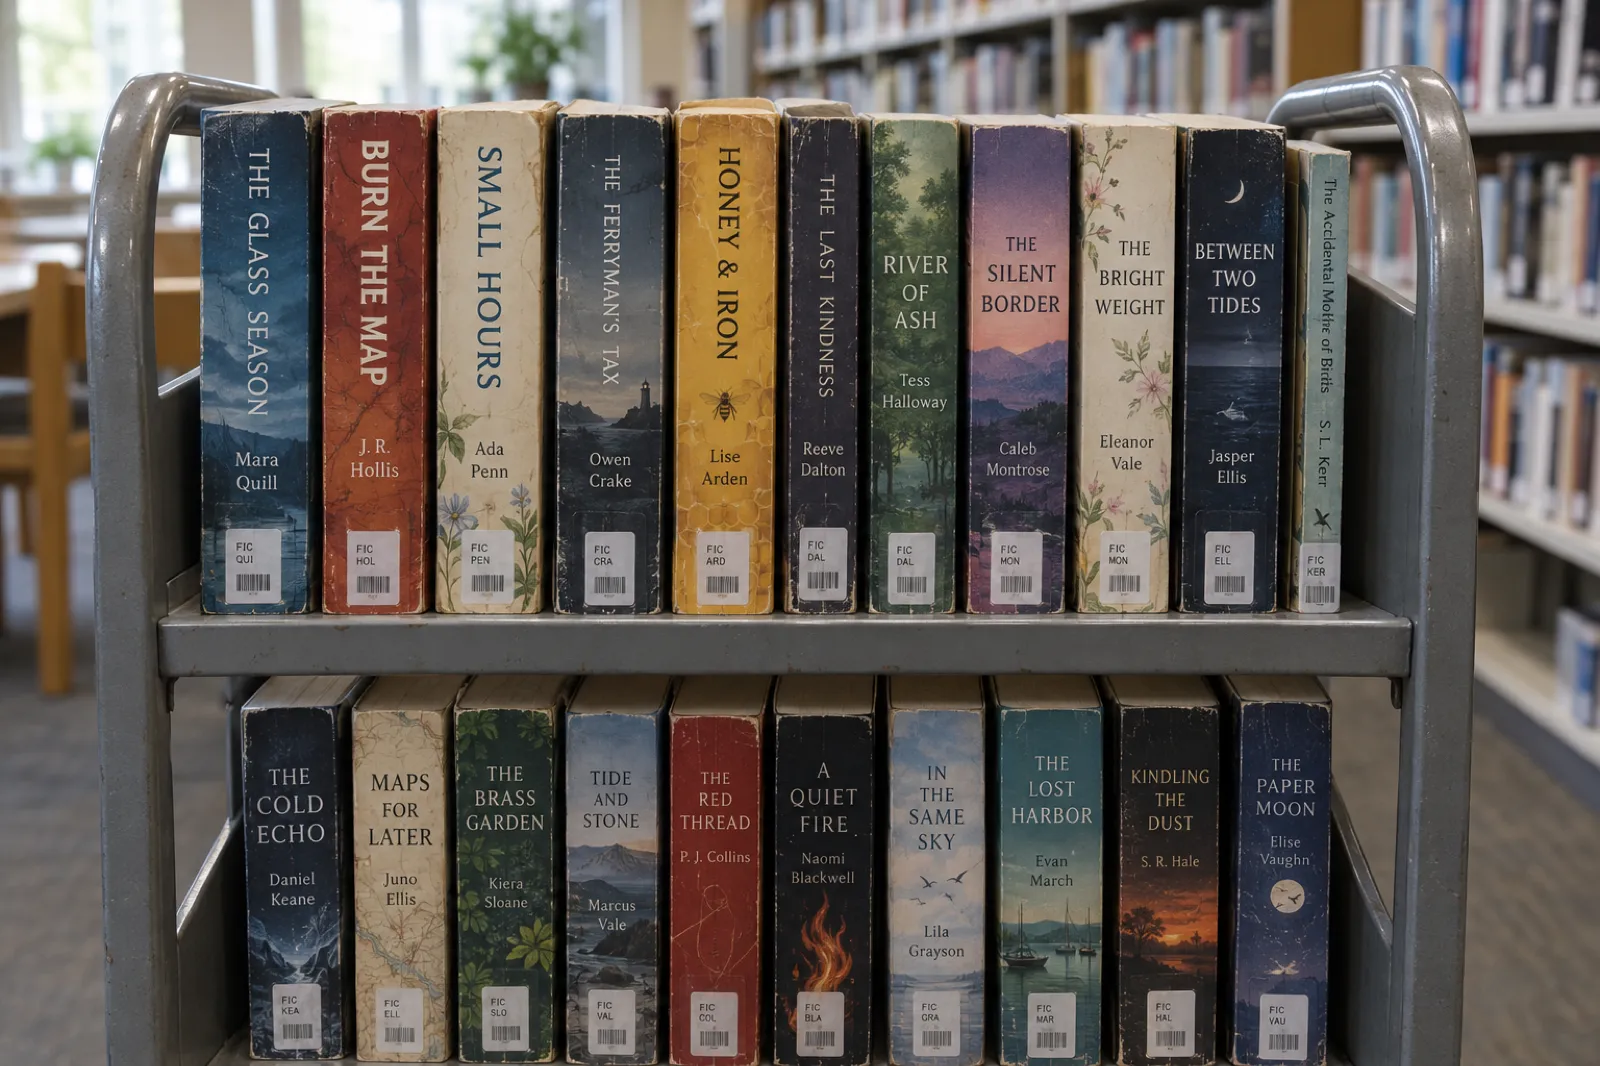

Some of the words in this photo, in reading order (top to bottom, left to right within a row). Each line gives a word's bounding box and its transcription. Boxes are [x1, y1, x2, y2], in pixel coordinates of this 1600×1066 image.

[248, 148, 270, 199] THE
[604, 154, 621, 191] THE
[361, 140, 390, 232] BURN
[1324, 178, 1337, 205] The
[477, 146, 503, 258] SMALL
[717, 147, 741, 250] HONEY
[819, 174, 835, 215] THE
[1005, 236, 1037, 252] THE
[1119, 241, 1151, 256] THE
[1195, 243, 1275, 260] BETWEEN
[1322, 210, 1337, 285] Accidental
[248, 212, 270, 296] GLASS
[819, 230, 835, 283] LAST
[602, 204, 621, 333] FERRYMAN'S
[717, 259, 739, 279] &
[883, 255, 949, 275] RIVER
[360, 244, 388, 305] THE
[987, 264, 1056, 283] SILENT
[1100, 270, 1165, 286] BRIGHT
[1212, 270, 1256, 287] TWO
[902, 284, 929, 302] OF
[981, 295, 1060, 313] BORDER
[1095, 299, 1166, 315] WEIGHT
[1207, 297, 1261, 314] TIDES
[716, 290, 739, 361] IRON
[894, 311, 937, 329] ASH
[476, 271, 502, 390] HOURS
[360, 315, 388, 386] MAP
[818, 296, 835, 398] KINDNESS
[1321, 339, 1333, 354] of
[247, 311, 269, 416] SEASON
[602, 346, 620, 385] TAX
[899, 373, 930, 387] Tess
[882, 394, 947, 412] Halloway
[1319, 420, 1331, 432] S.
[358, 438, 371, 457] J.
[375, 438, 391, 454] R.
[475, 441, 504, 456] Ada
[803, 441, 844, 456] Reeve
[999, 441, 1037, 456] Caleb
[1100, 434, 1154, 449] Eleanor
[1319, 437, 1331, 450] L.
[235, 452, 279, 467] Mara
[589, 452, 631, 466] Owen
[710, 449, 741, 463] Lise
[1111, 456, 1143, 471] Vale
[1208, 449, 1255, 465] Jasper
[350, 462, 399, 478] Hollis
[471, 464, 509, 479] Penn
[801, 462, 846, 477] Dalton
[986, 462, 1050, 477] Montrose
[1217, 470, 1247, 484] Ellis
[1318, 456, 1330, 488] Kerr
[236, 475, 278, 492] Quill
[589, 474, 632, 488] Crake
[701, 472, 748, 486] Arden
[236, 542, 253, 552] FIC
[356, 544, 373, 554] FIC
[471, 543, 488, 553] FIC
[594, 545, 611, 554] FIC
[706, 545, 724, 554] FIC
[807, 541, 824, 550] FIC
[896, 546, 913, 555] FIC
[1001, 545, 1017, 554] FIC
[1109, 544, 1125, 553] FIC
[1215, 545, 1231, 554] FIC
[236, 555, 253, 565] QUI
[356, 556, 375, 566] HOL
[471, 556, 490, 565] PEN
[594, 557, 613, 566] CRA
[706, 556, 726, 566] ARD
[807, 553, 826, 562] DAL
[896, 557, 914, 566] DAL
[1000, 557, 1020, 566] MON
[1108, 556, 1128, 565] MON
[1214, 557, 1232, 566] ELL
[1307, 556, 1324, 565] FIC
[1307, 567, 1326, 577] KER
[817, 762, 830, 779] A
[1034, 756, 1069, 771] THE
[1272, 758, 1301, 772] THE
[268, 767, 311, 786] THE
[486, 765, 524, 782] THE
[590, 770, 631, 786] TIDE
[700, 772, 730, 785] THE
[927, 765, 946, 781] IN
[1131, 769, 1210, 784] KINDLING
[371, 773, 430, 792] MAPS
[1029, 780, 1076, 797] LOST
[1256, 778, 1316, 794] PAPER
[475, 789, 536, 807] BRASS
[593, 793, 628, 807] AND
[699, 792, 732, 807] RED
[790, 788, 858, 808] QUIET
[919, 787, 954, 802] THE
[1155, 793, 1185, 807] THE
[256, 795, 324, 815] COLD
[382, 802, 419, 818] FOR
[1256, 801, 1316, 817] MOON
[466, 814, 545, 831] GARDEN
[583, 813, 640, 829] STONE
[679, 814, 751, 830] THREAD
[909, 809, 965, 825] SAME
[1011, 807, 1093, 824] HARBOR
[1148, 815, 1194, 831] DUST
[800, 816, 848, 833] FIRE
[257, 823, 325, 844] ECHO
[368, 828, 433, 846] LATER
[918, 833, 955, 850] SKY
[1270, 835, 1301, 848] Elise
[680, 851, 690, 863] P.
[694, 851, 703, 864] J.
[707, 850, 751, 863] Collins
[801, 852, 845, 865] Naomi
[1035, 855, 1068, 867] Evan
[1141, 856, 1152, 868] S.
[1156, 856, 1168, 867] R.
[1172, 855, 1200, 867] Hale
[1260, 854, 1310, 868] Vaughn
[269, 872, 315, 886] Daniel
[383, 872, 418, 887] Juno
[489, 877, 523, 890] Kiera
[791, 871, 855, 884] Blackwell
[1030, 874, 1073, 887] March
[271, 892, 316, 906] Keane
[386, 892, 416, 906] Ellis
[484, 896, 528, 909] Sloane
[588, 899, 636, 912] Marcus
[598, 918, 627, 931] Vale
[924, 925, 950, 938] Lila
[908, 945, 965, 961] Grayson
[281, 996, 298, 1005] FIC
[384, 1000, 400, 1008] FIC
[490, 998, 506, 1006] FIC
[597, 1002, 612, 1010] FIC
[700, 1003, 716, 1012] FIC
[805, 1003, 821, 1012] FIC
[921, 1003, 937, 1011] FIC
[1156, 1003, 1171, 1011] FIC
[281, 1007, 300, 1015] KEA
[384, 1010, 400, 1018] ELL
[597, 1012, 614, 1021] VAL
[1036, 1005, 1052, 1013] FIC
[1269, 1006, 1285, 1014] FIC
[699, 1014, 717, 1022] COL
[804, 1014, 822, 1022] BLA
[1036, 1015, 1054, 1024] MAR
[1155, 1014, 1172, 1022] HAL
[1269, 1017, 1286, 1025] VAU
